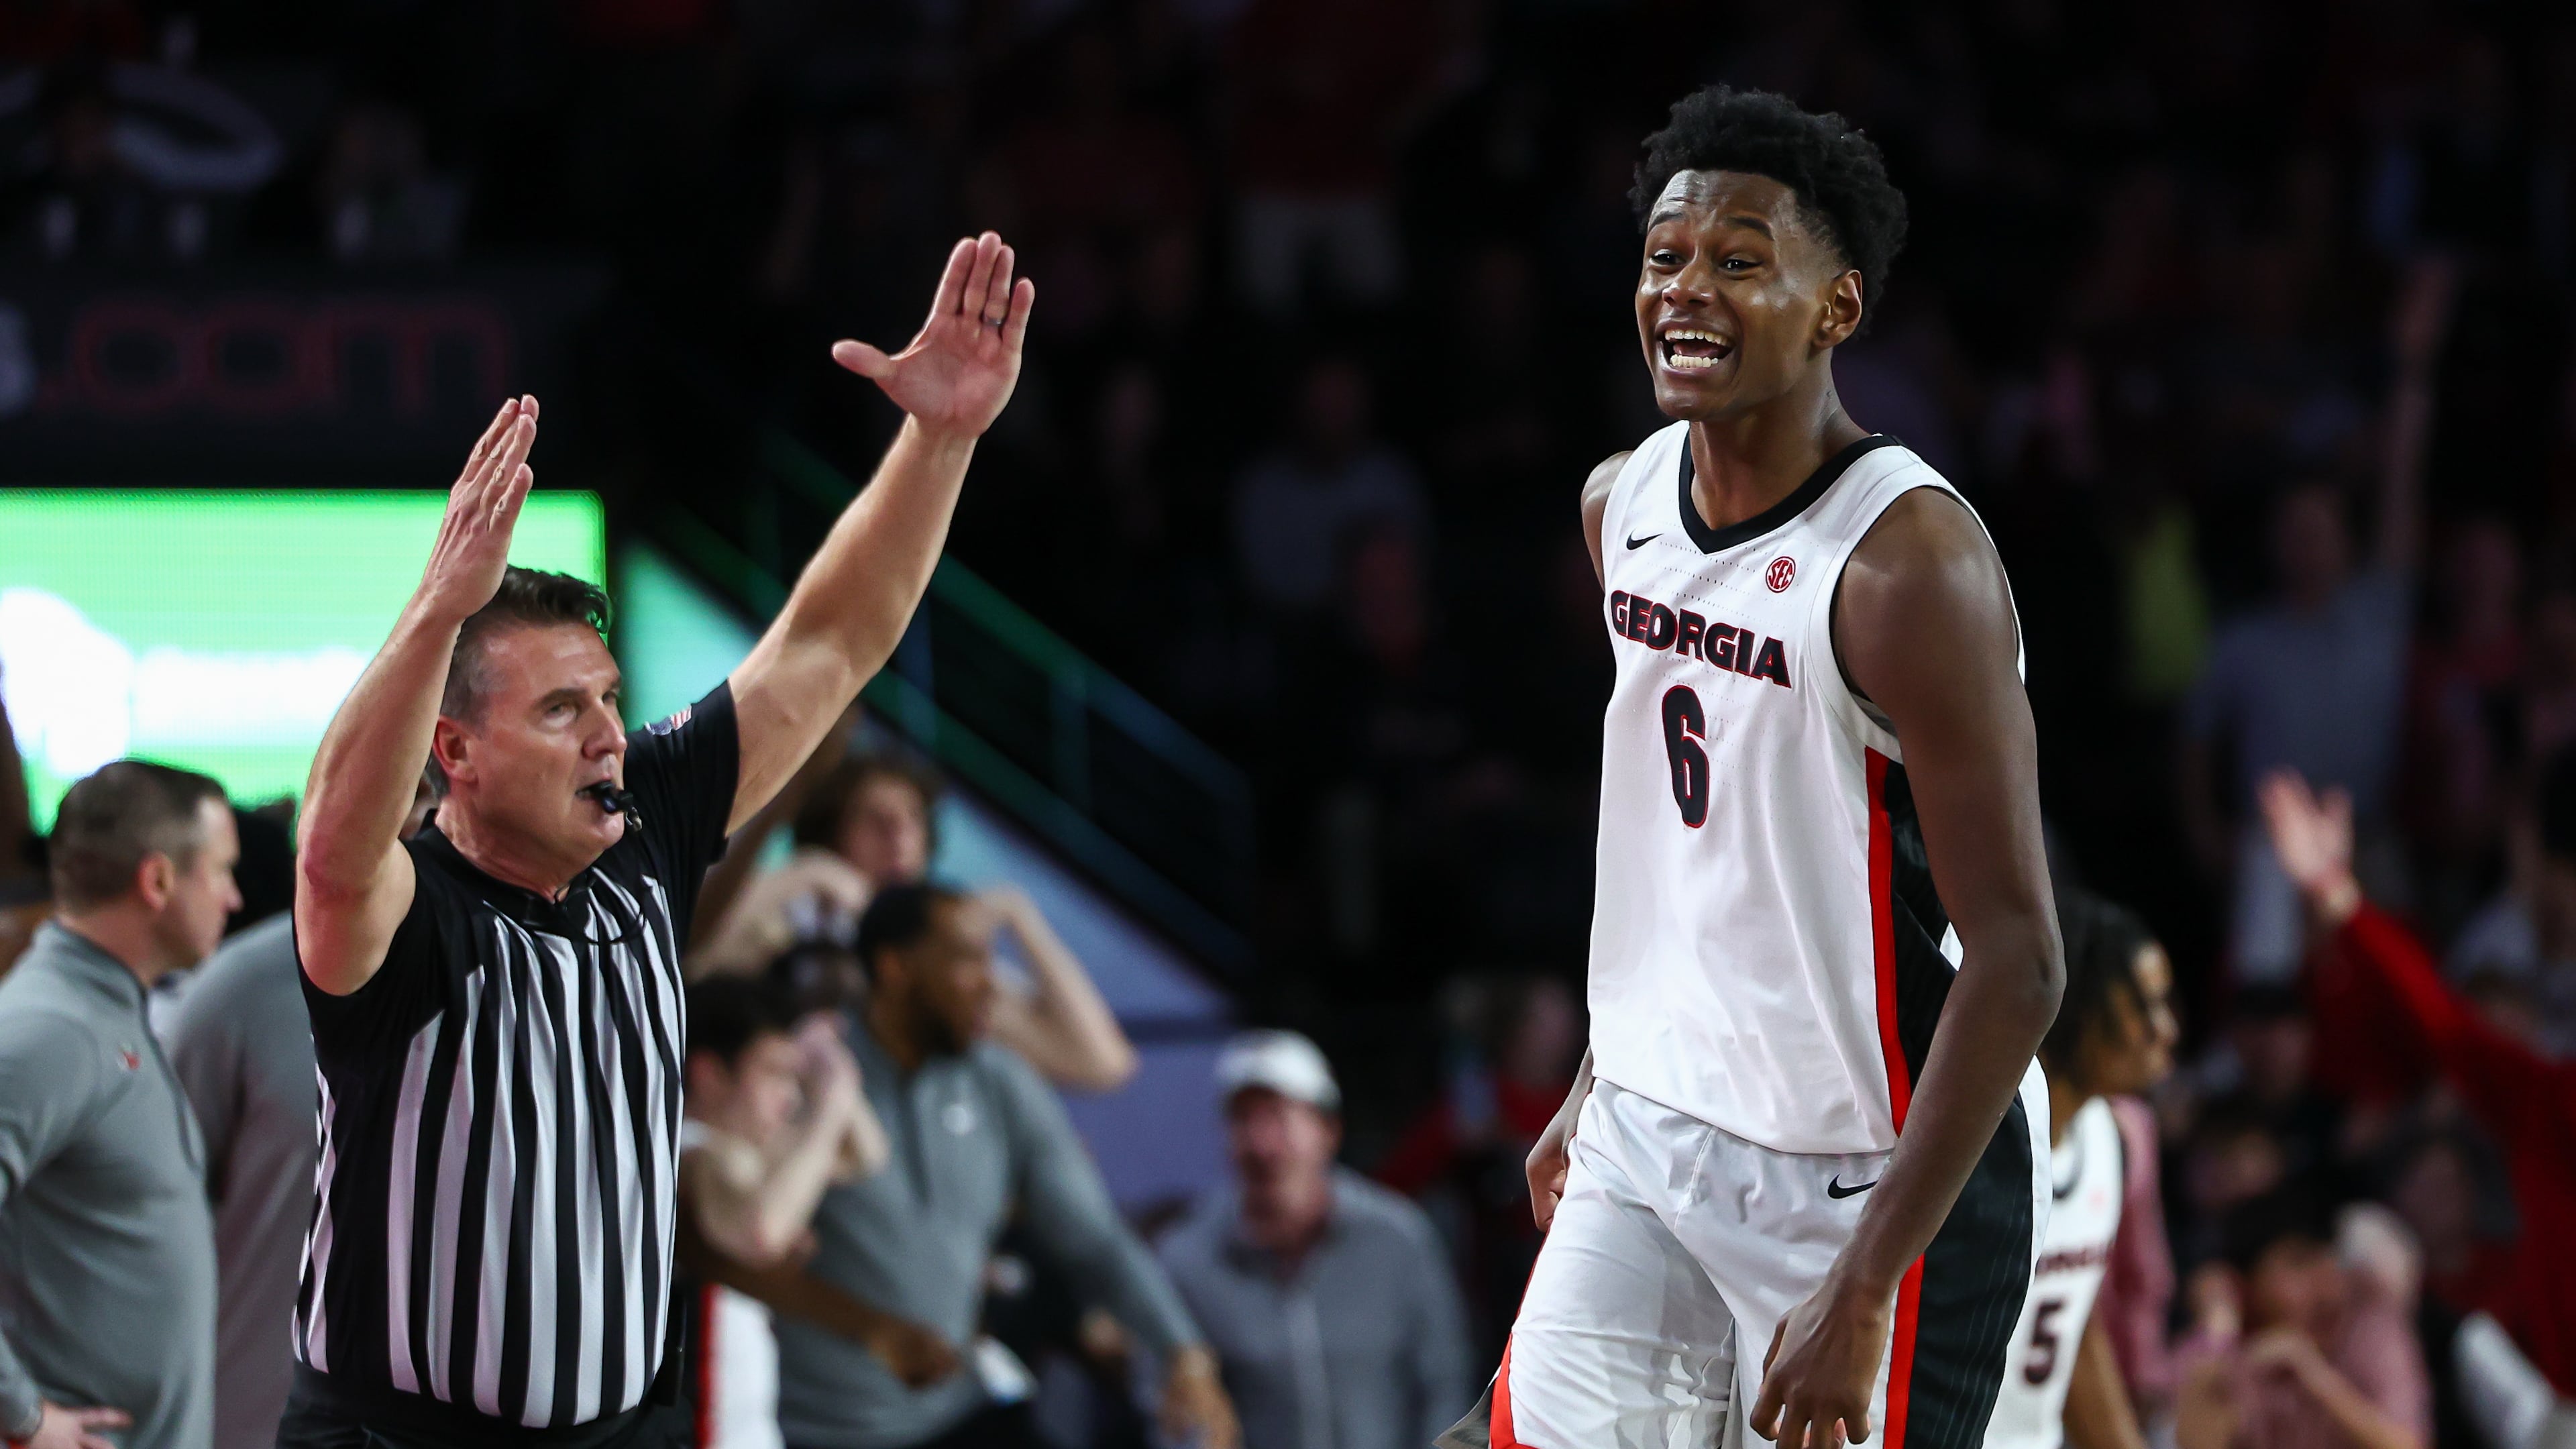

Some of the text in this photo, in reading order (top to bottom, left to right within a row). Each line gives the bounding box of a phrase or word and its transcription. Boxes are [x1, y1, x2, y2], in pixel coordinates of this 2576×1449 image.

[1768, 559, 1793, 590] SEC
[1610, 590, 1792, 688] GEORGIA
[1662, 685, 1709, 828] 6
[2023, 1299, 2065, 1385] 5
